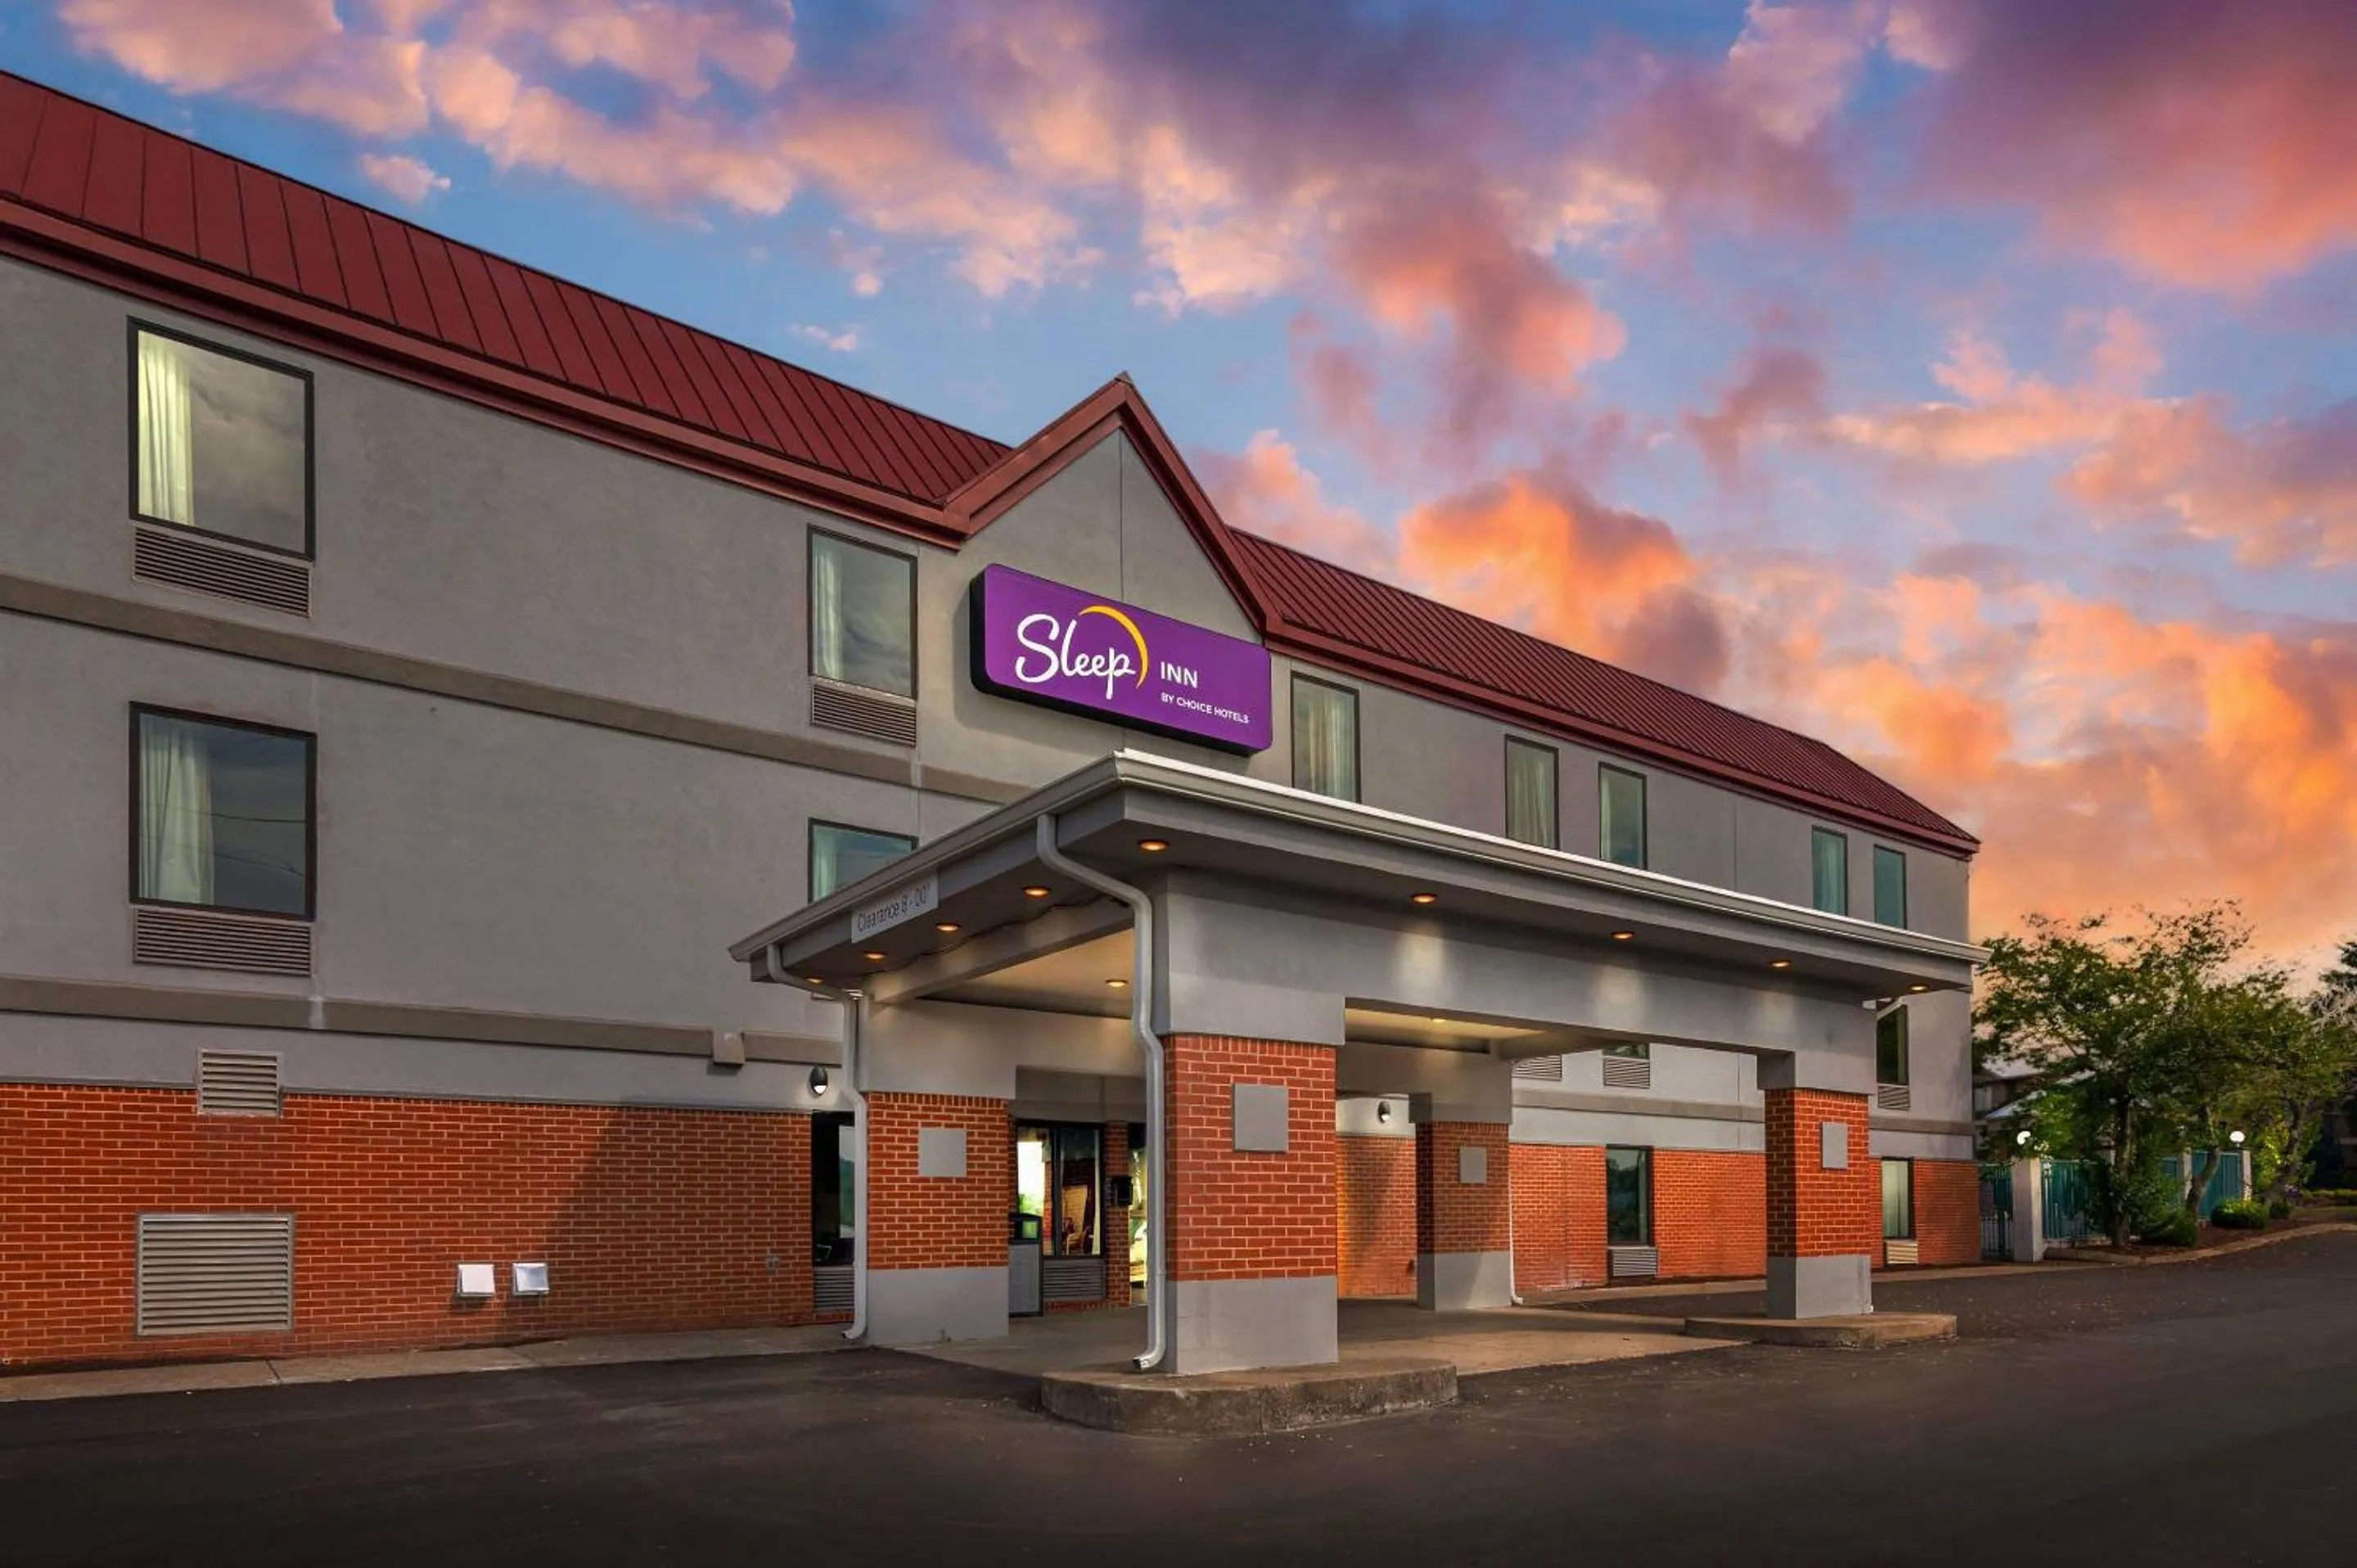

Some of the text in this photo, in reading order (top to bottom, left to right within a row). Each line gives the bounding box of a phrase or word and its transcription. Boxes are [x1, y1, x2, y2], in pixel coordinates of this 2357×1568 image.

[1015, 613, 1198, 700] Sleep INN
[1161, 692, 1249, 723] BY CHOICE HOTELS
[858, 901, 899, 932] Clearance
